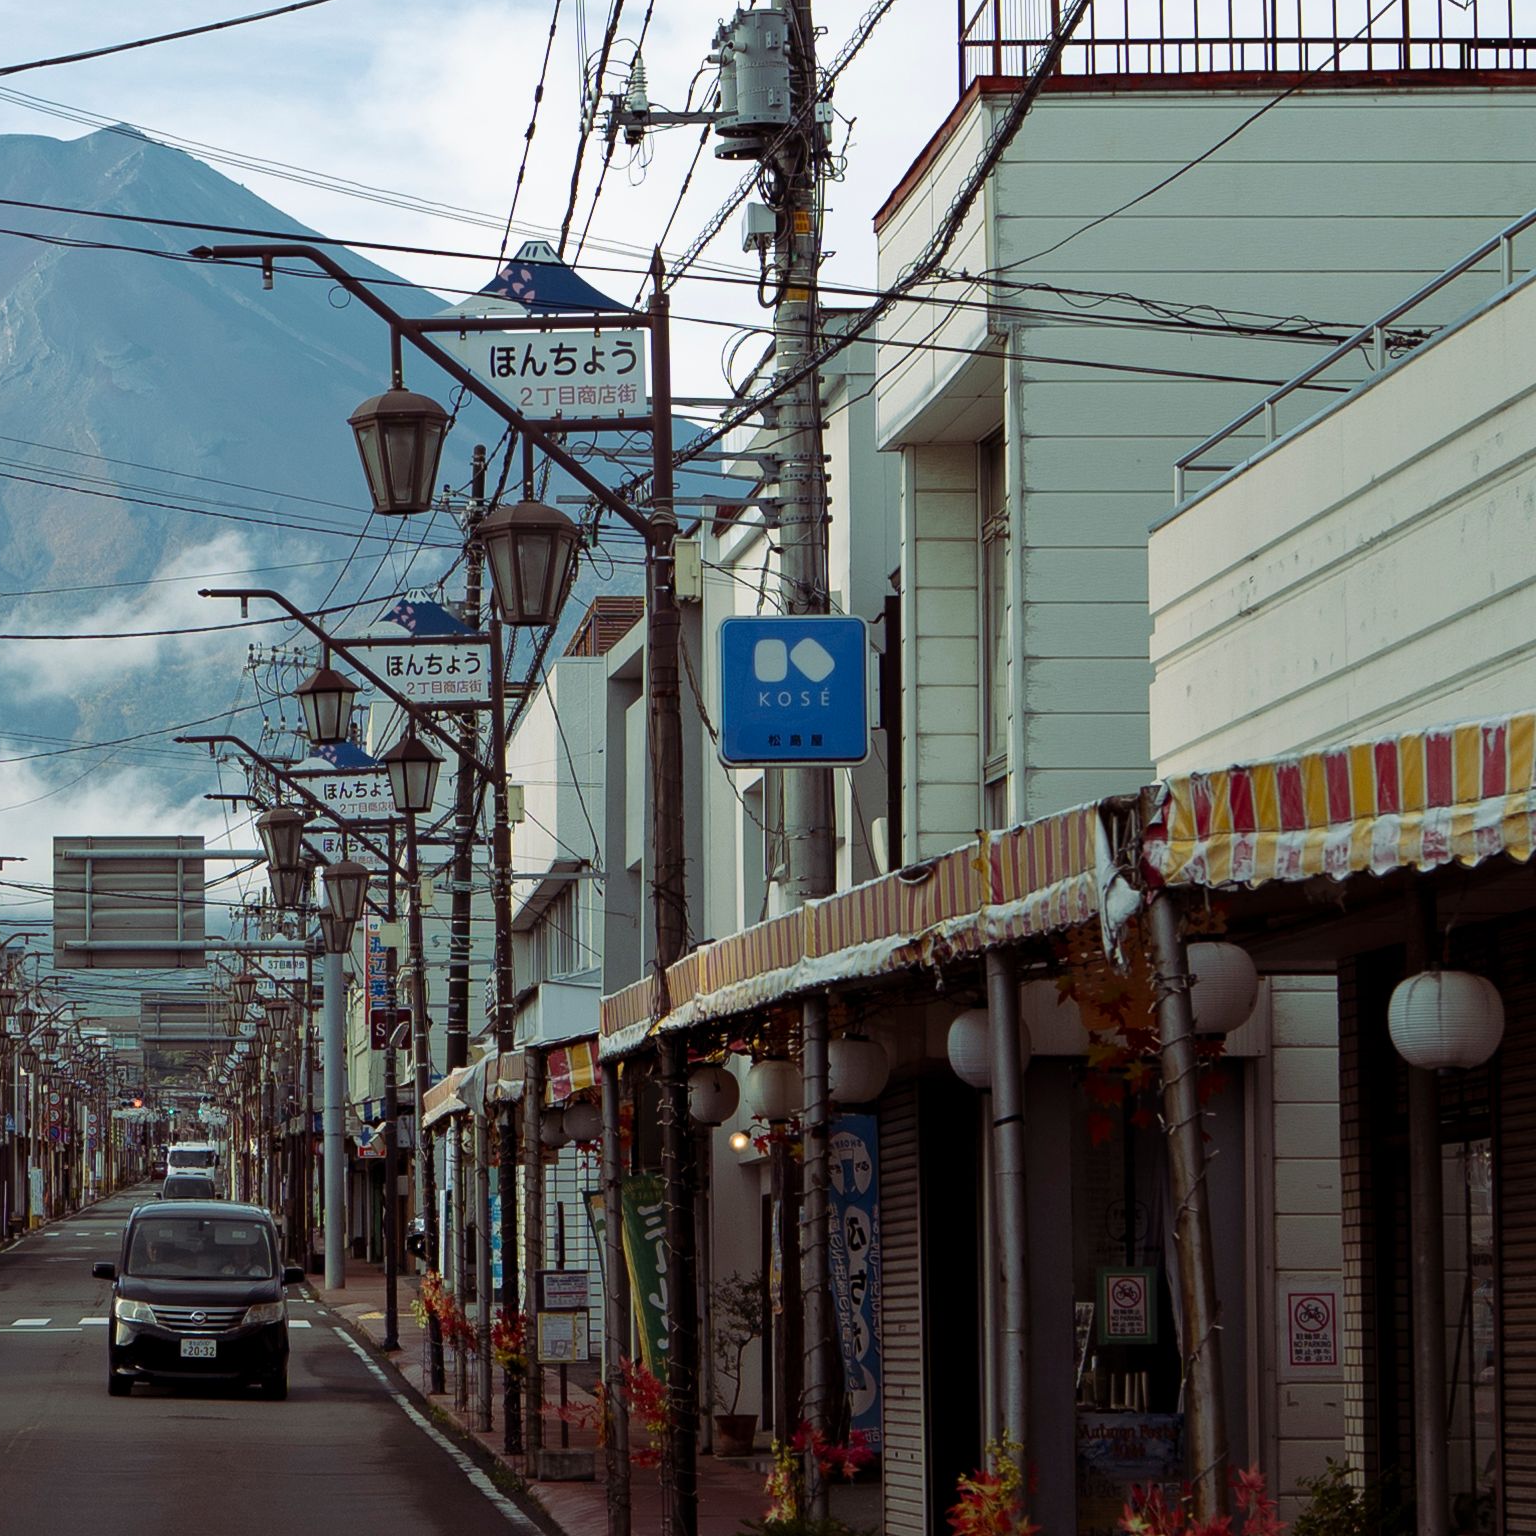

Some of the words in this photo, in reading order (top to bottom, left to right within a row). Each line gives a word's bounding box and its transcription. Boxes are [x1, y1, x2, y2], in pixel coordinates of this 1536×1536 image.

[489, 340, 637, 378] ほんちょう
[520, 383, 637, 406] 2丁目商店街
[386, 652, 481, 677] ほんちょう
[406, 680, 483, 695] 2丁目商店街
[759, 687, 831, 707] KOSÉ
